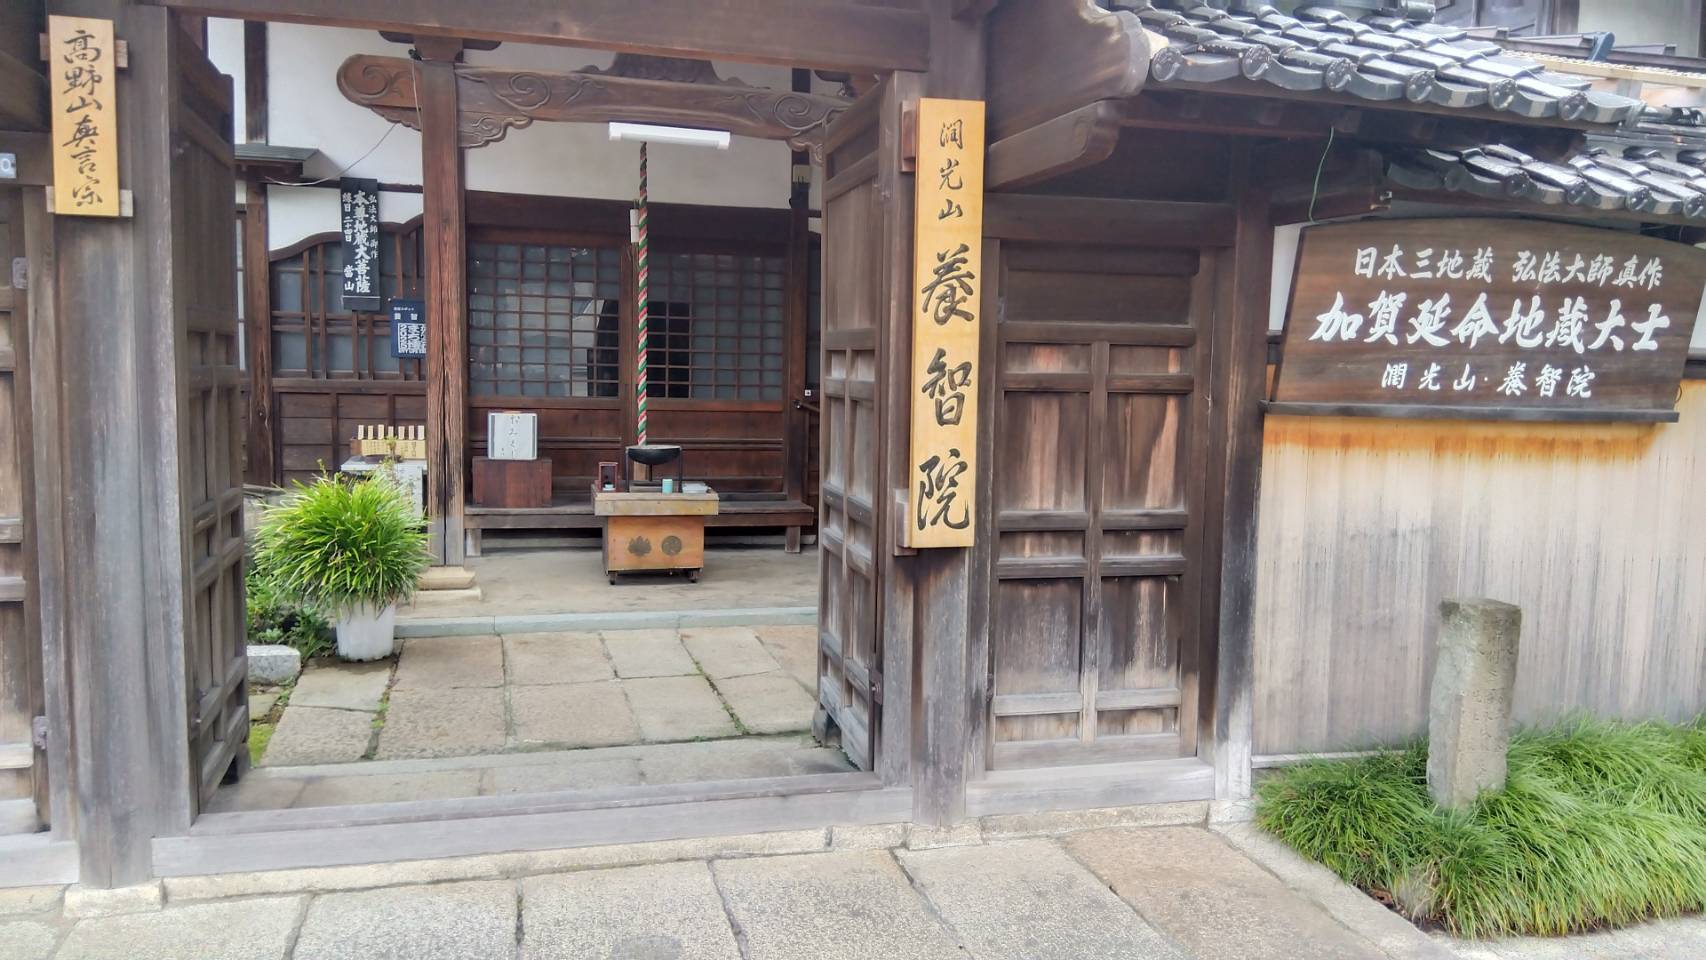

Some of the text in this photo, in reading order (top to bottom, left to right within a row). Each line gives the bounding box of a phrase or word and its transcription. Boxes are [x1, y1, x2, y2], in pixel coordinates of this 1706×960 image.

[1354, 244, 1663, 291] 日本三地蔵 弘法大師真作
[1308, 289, 1672, 354] 加賀延命地蔵大士
